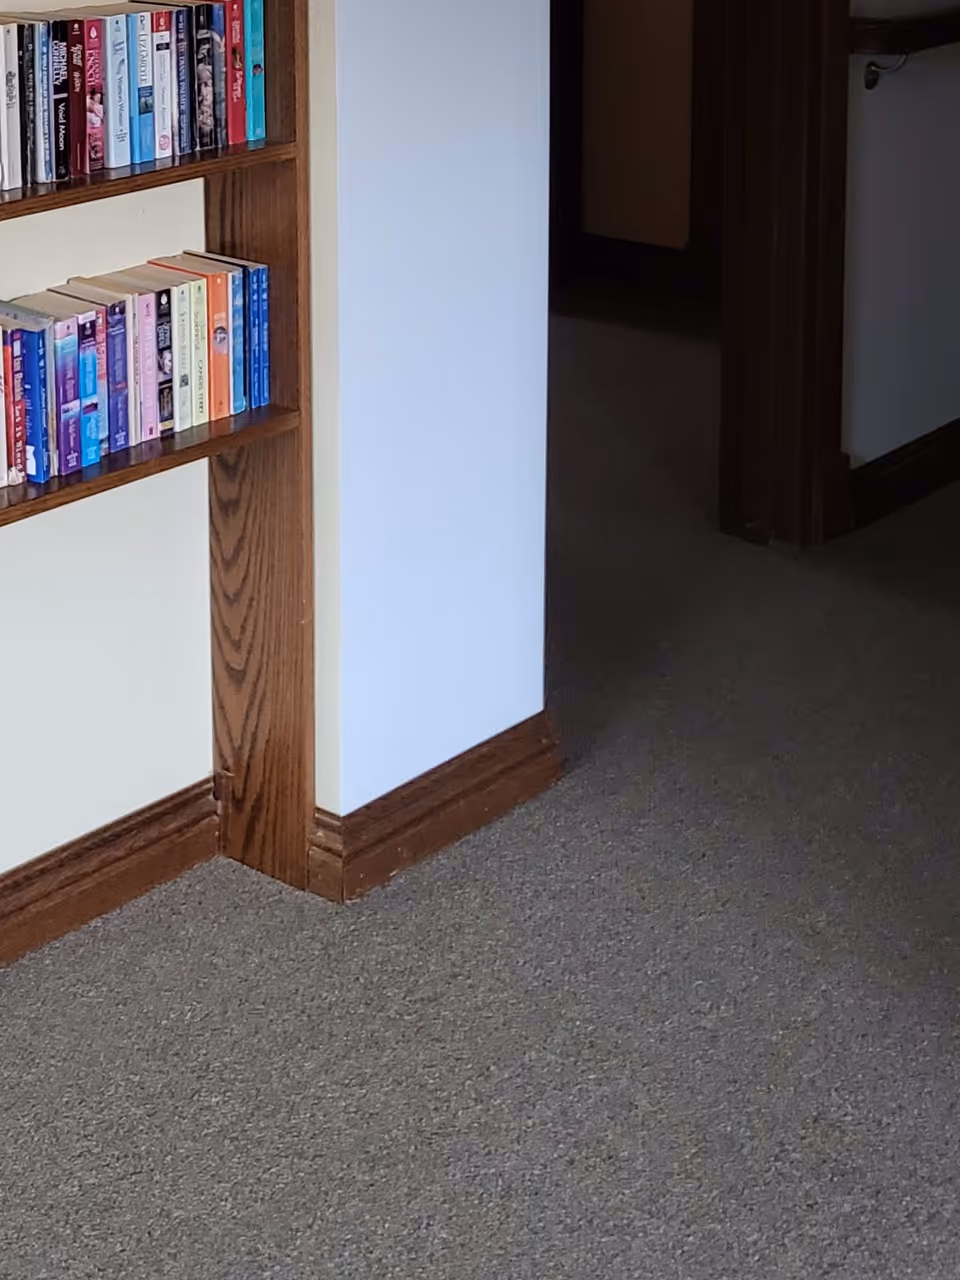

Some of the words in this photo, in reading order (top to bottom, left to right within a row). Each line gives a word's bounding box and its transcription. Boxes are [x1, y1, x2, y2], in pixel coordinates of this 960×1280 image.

[138, 34, 148, 49] LIZ
[53, 40, 61, 85] CONNELLY
[87, 50, 95, 85] ENOCH
[139, 50, 149, 85] CARLYLE
[58, 103, 66, 124] Void
[14, 373, 23, 401] Rankin
[15, 405, 23, 420] Let
[16, 427, 23, 437] It
[16, 441, 24, 469] Bleed
